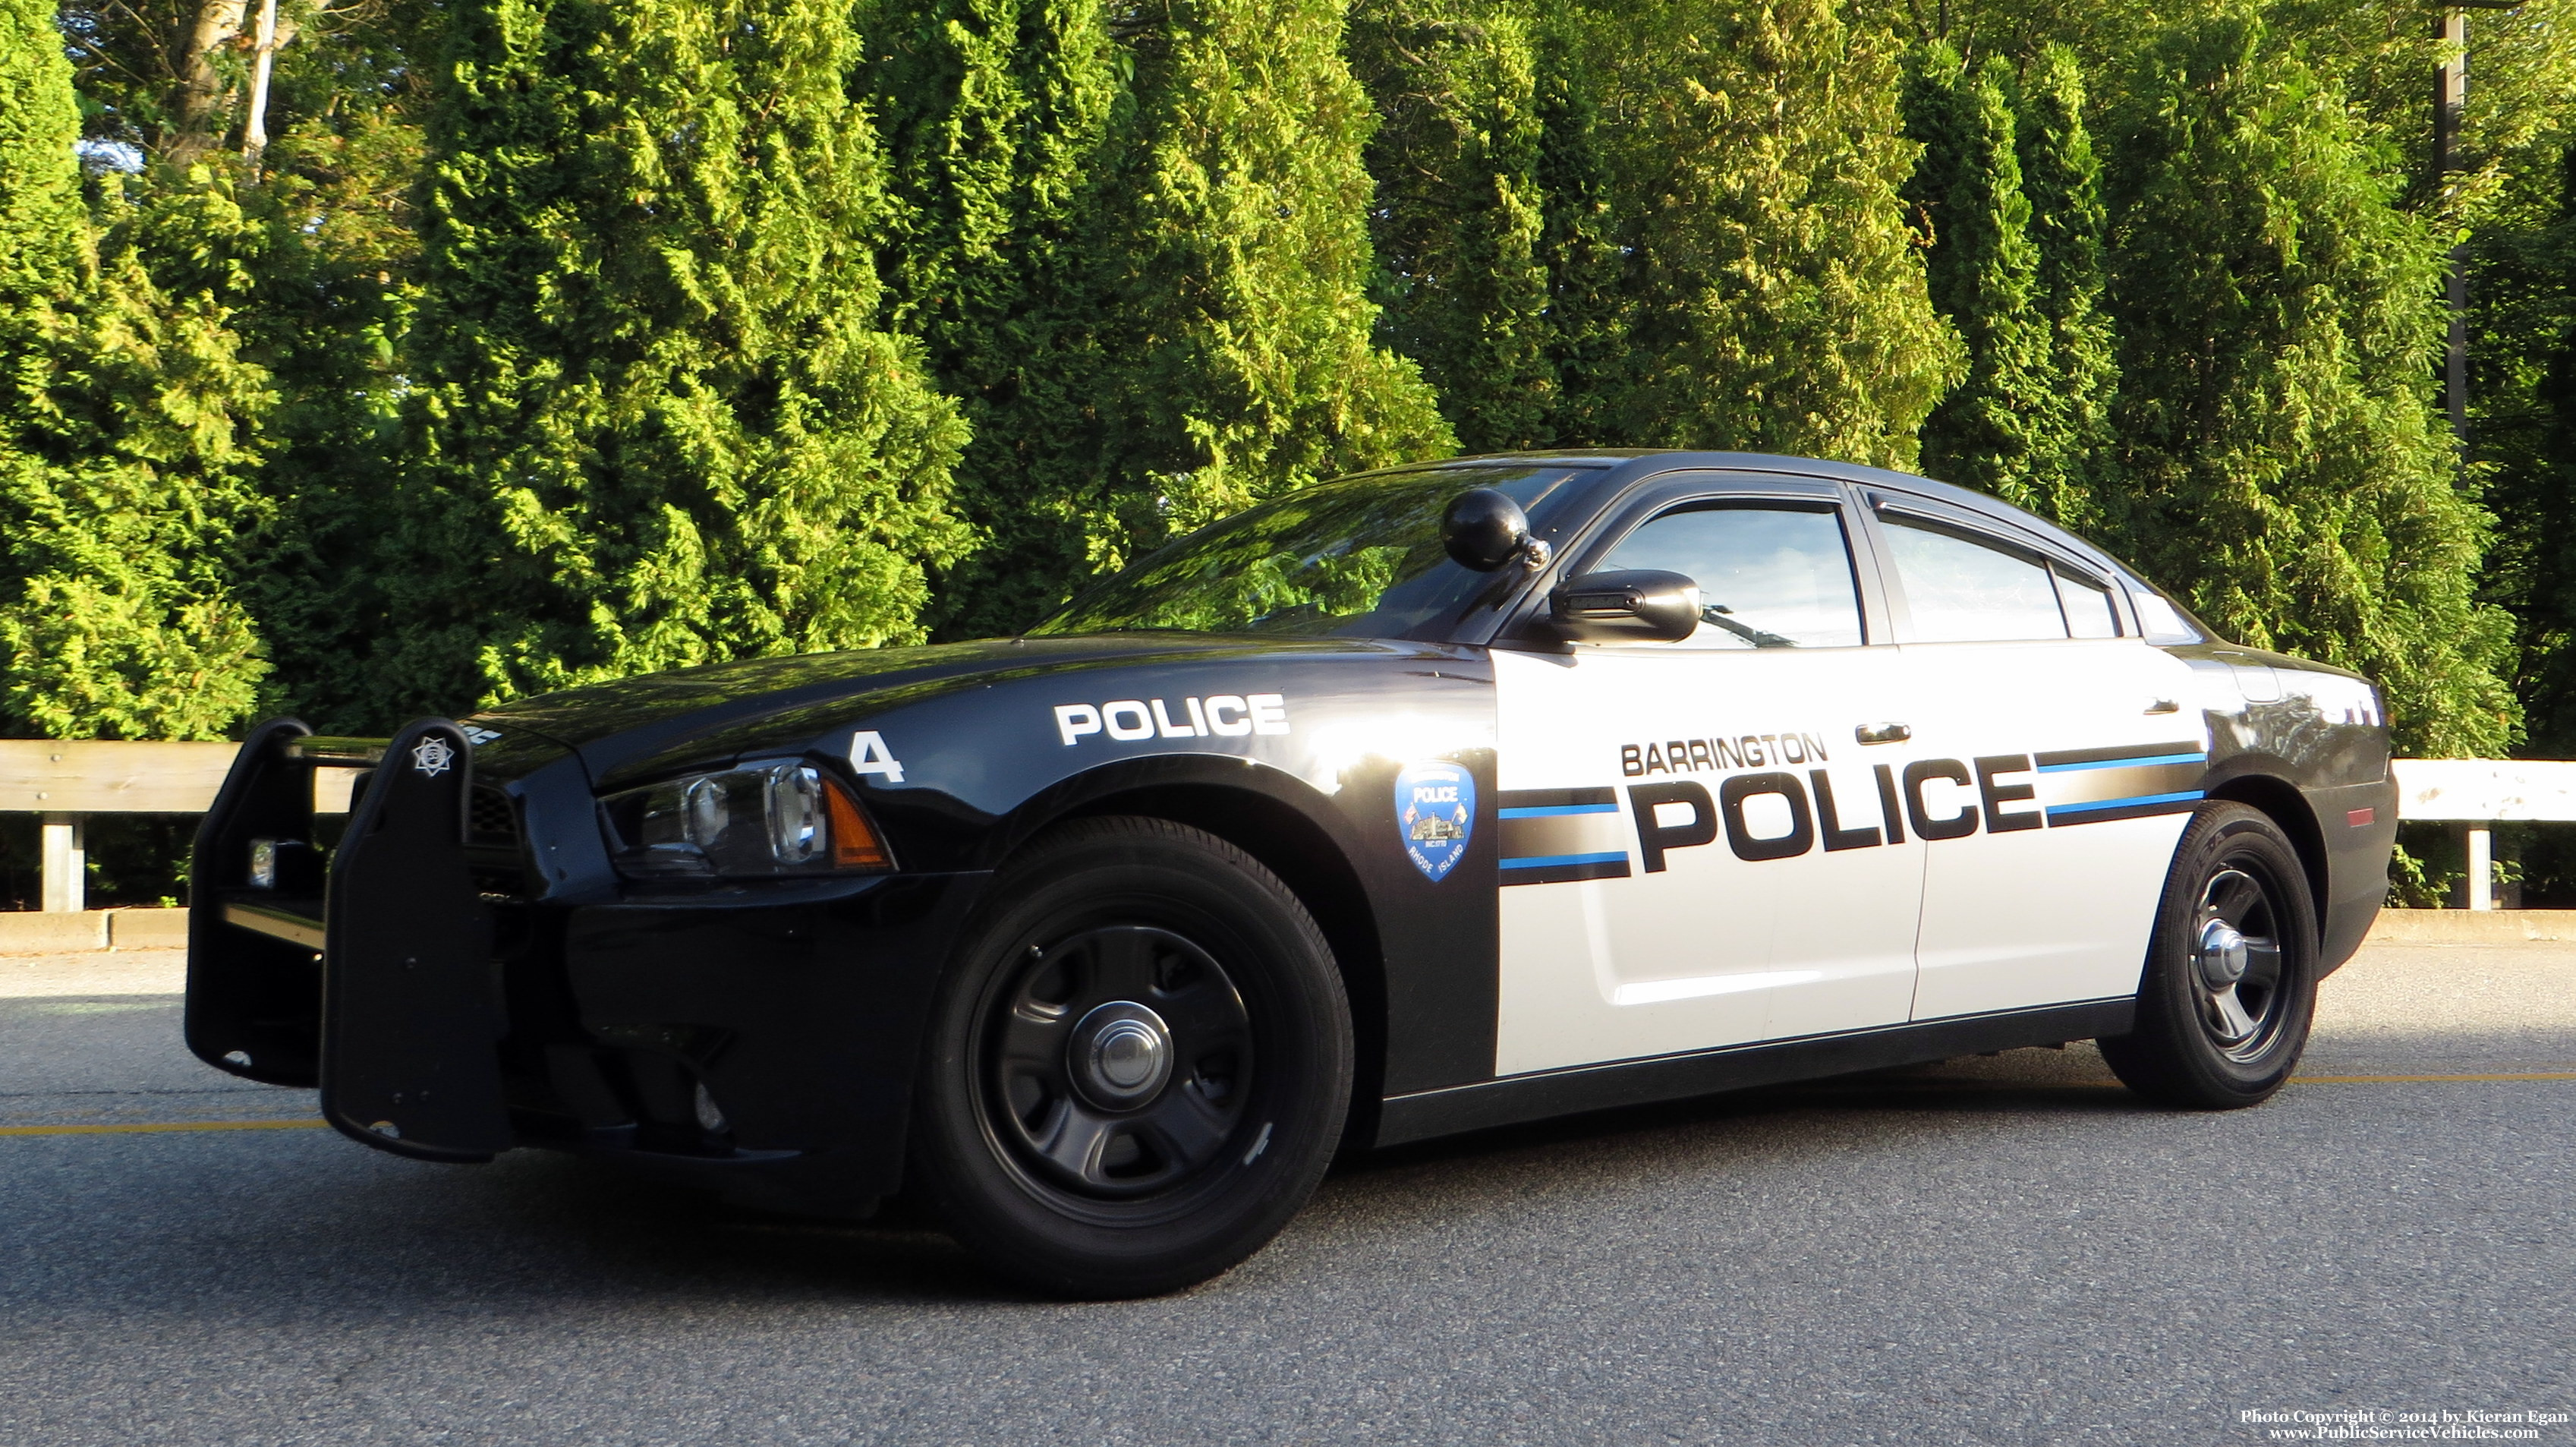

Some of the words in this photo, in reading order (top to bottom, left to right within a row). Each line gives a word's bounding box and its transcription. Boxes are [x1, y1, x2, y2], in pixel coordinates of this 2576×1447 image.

[1054, 693, 1290, 746] POLICE
[850, 730, 905, 783] 4
[1621, 732, 1828, 777] BARRINGTON
[1413, 786, 1459, 803] POLICE
[1627, 754, 2043, 874] POLICE
[1409, 845, 1434, 873] RHODE
[1438, 843, 1464, 873] ISLAND
